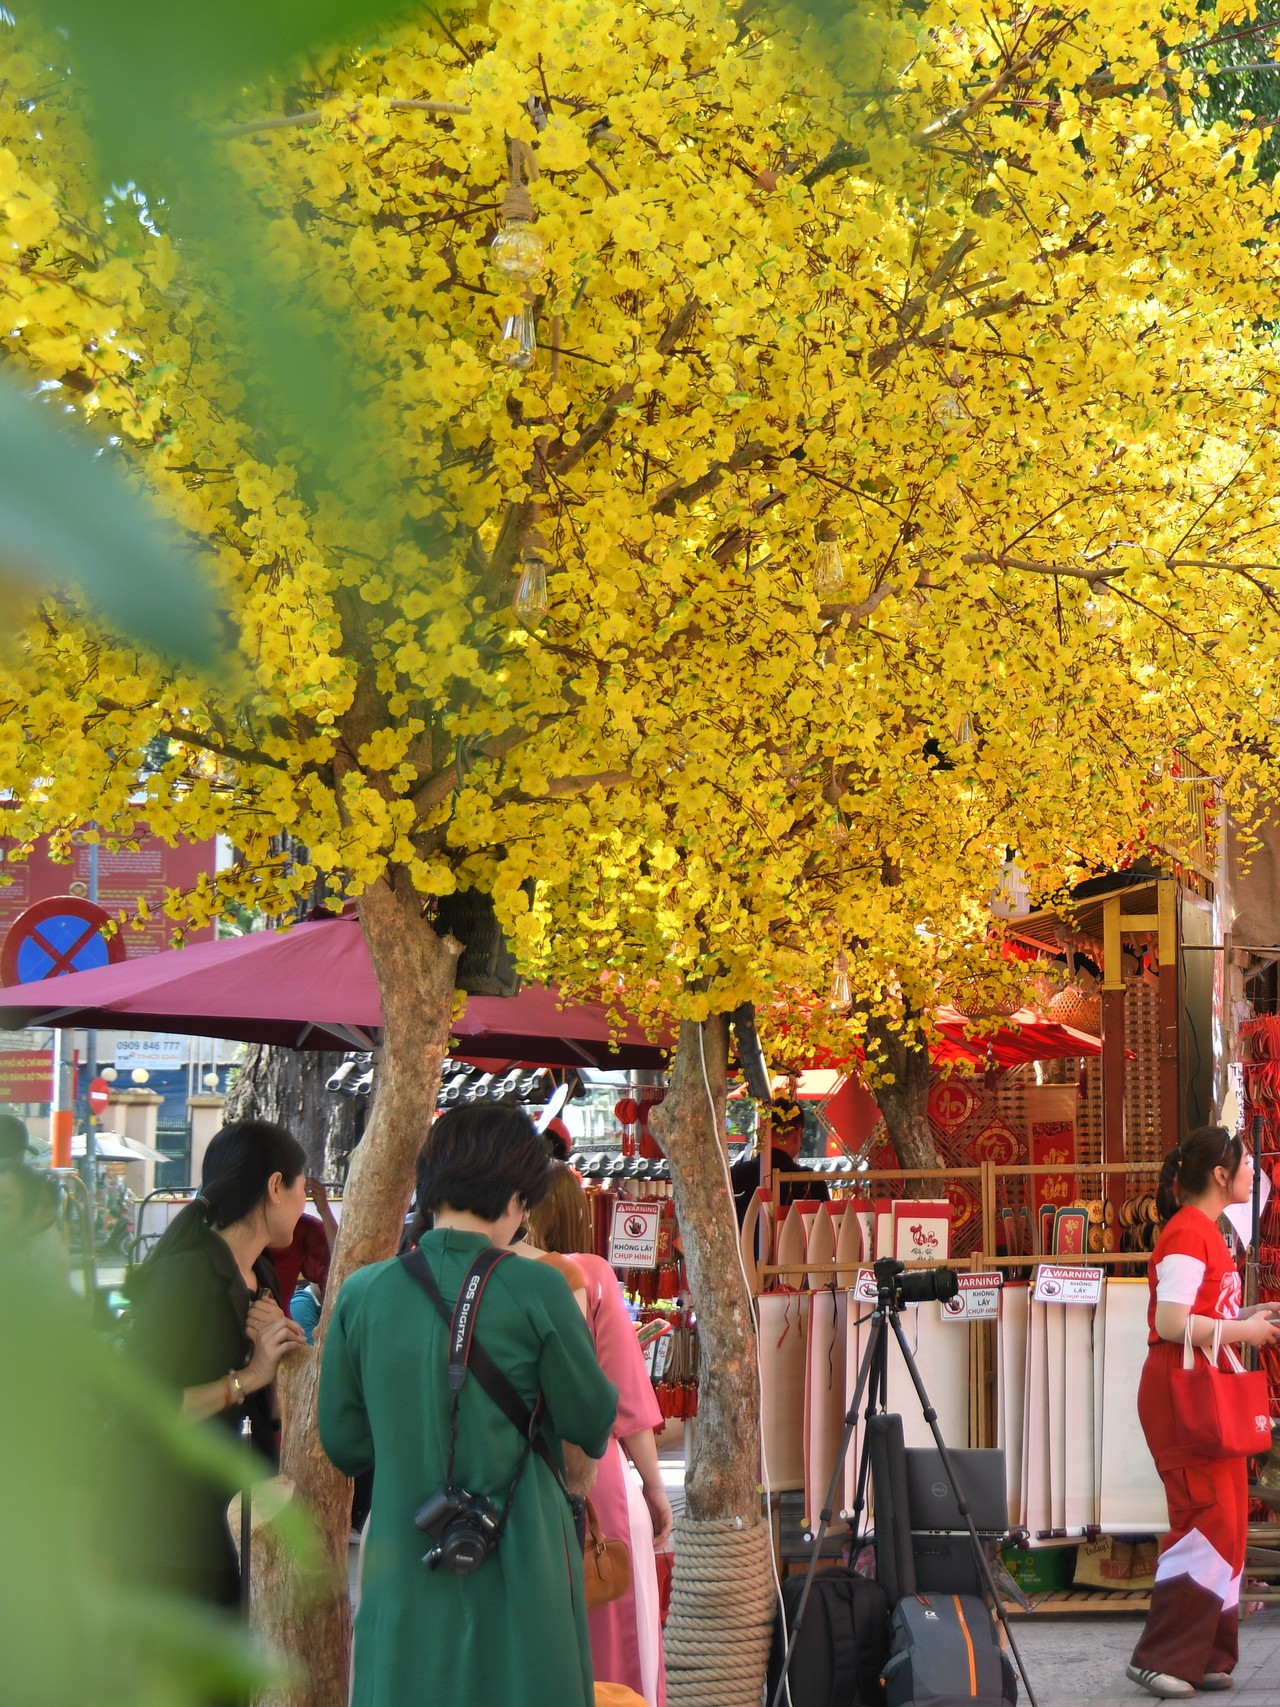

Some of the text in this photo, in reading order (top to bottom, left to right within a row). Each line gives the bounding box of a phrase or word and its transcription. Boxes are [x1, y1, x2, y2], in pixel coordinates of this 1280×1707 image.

[625, 1205, 658, 1213] WARNING
[614, 1244, 640, 1252] KHÔNG
[614, 1252, 652, 1261] CHỤP HÌNH
[1052, 1270, 1100, 1279] WARNING
[455, 1275, 480, 1352] EOS DIGITAL
[968, 1306, 998, 1315] CHỤP HÌN
